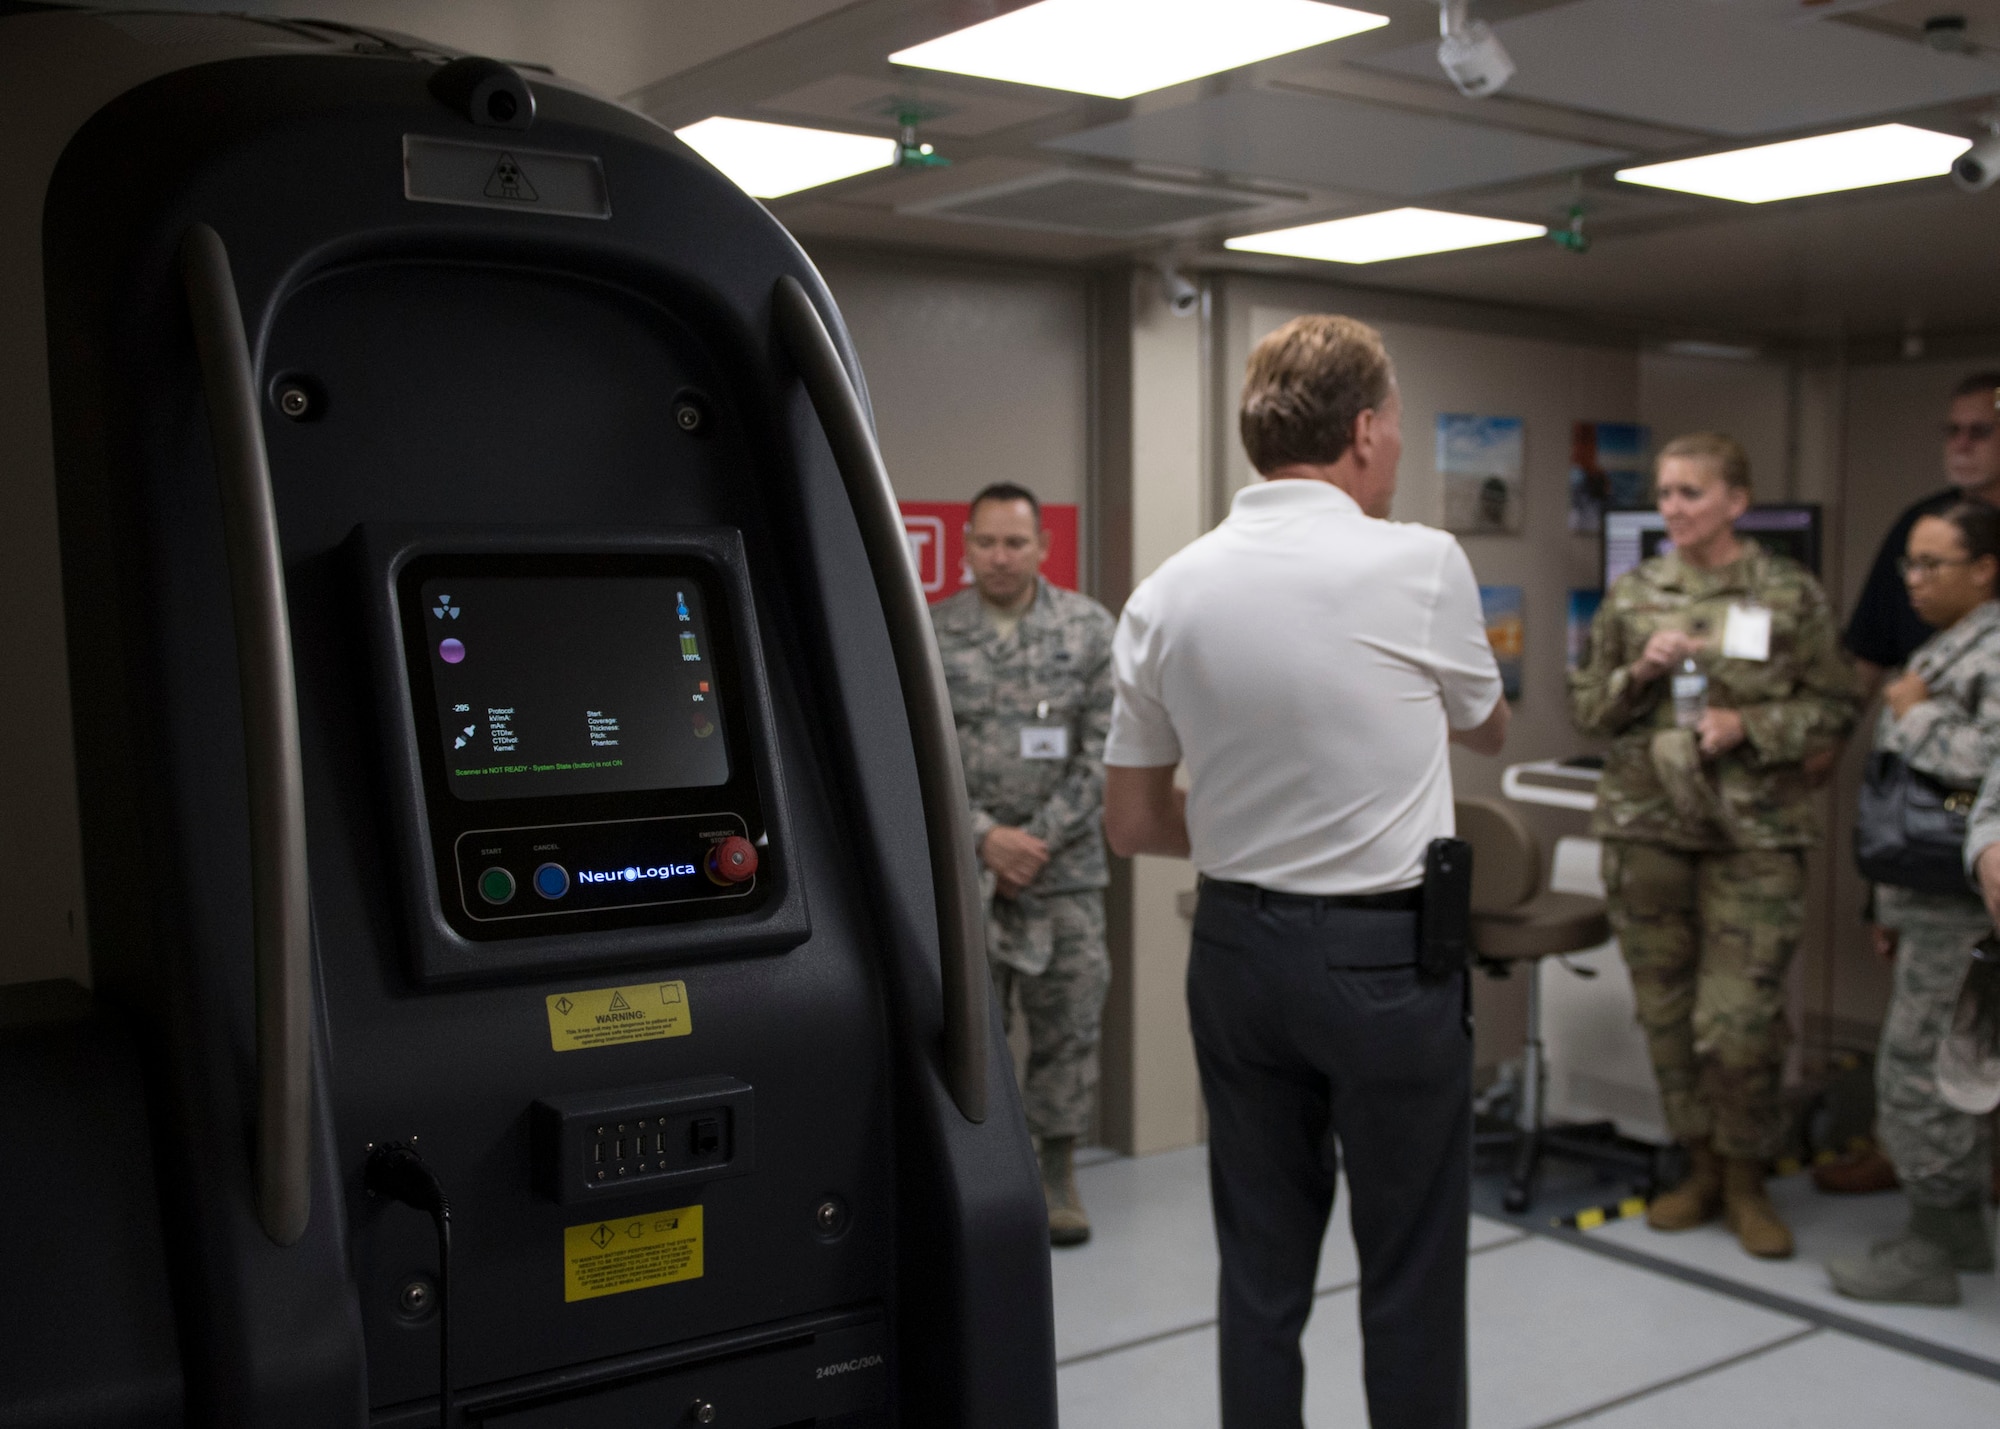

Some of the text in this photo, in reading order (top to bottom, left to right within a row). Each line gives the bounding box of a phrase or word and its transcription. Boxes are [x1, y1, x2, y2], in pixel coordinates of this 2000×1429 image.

[682, 653, 701, 661] 100%
[488, 707, 515, 715] Protocol:
[591, 739, 620, 747] Phantom:
[455, 767, 482, 776] Scanner
[489, 766, 503, 774] NOT
[504, 764, 528, 773] READY
[532, 763, 555, 772] System
[556, 762, 572, 770] State
[573, 761, 595, 770] (button)
[699, 830, 736, 839] EMERGENCY
[480, 847, 502, 856] START
[595, 1011, 646, 1024] WARNING:
[816, 1355, 884, 1379] 240VAC/30A
